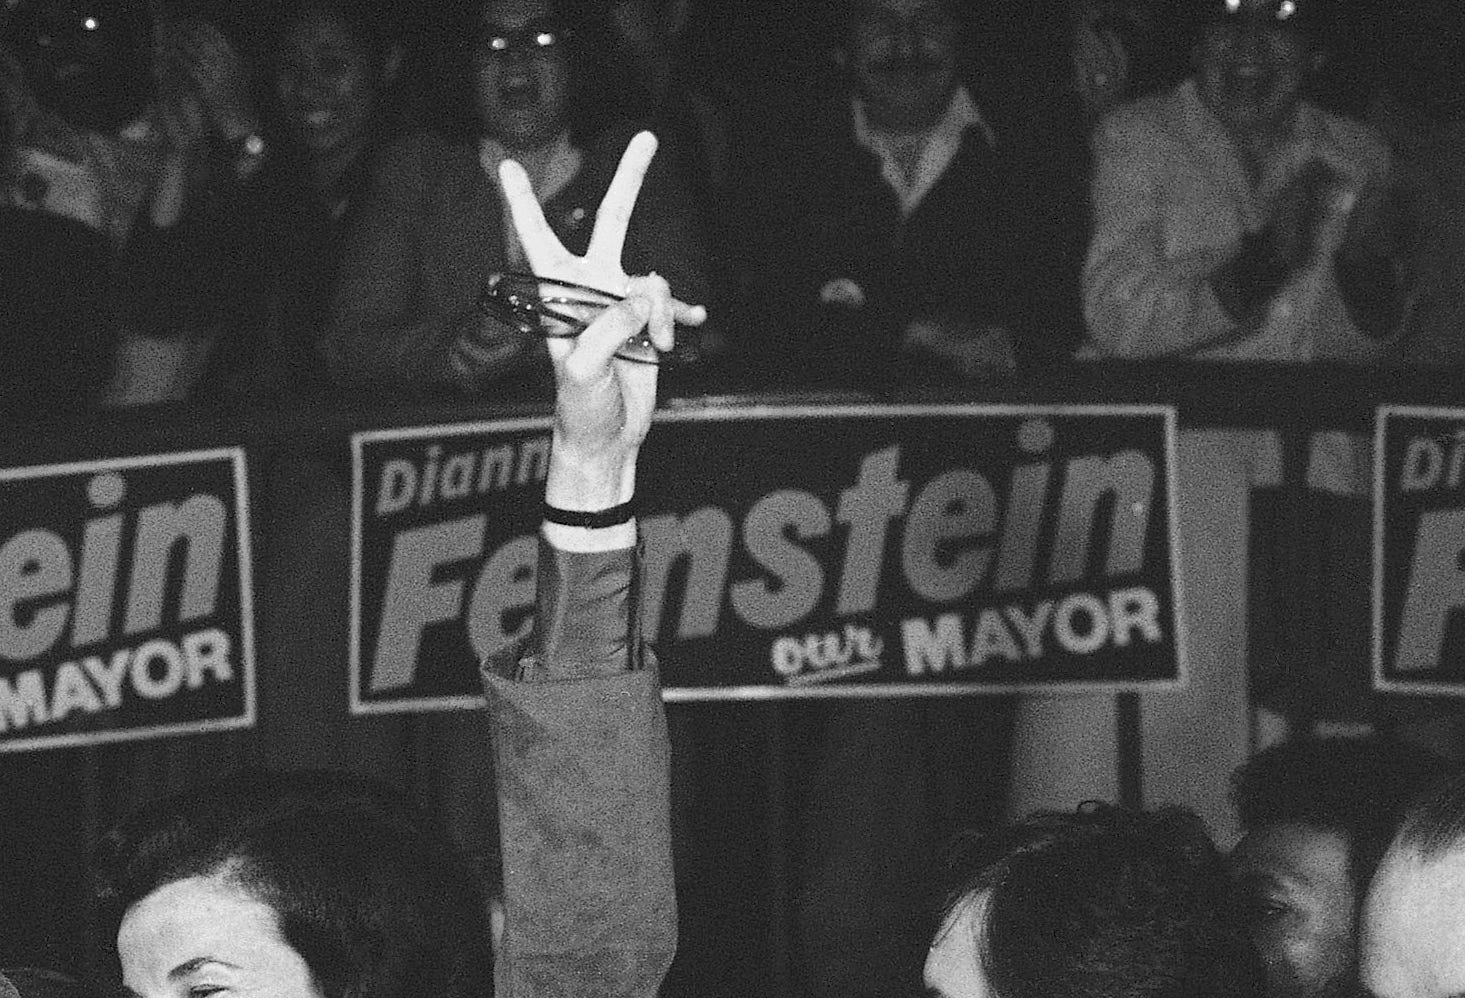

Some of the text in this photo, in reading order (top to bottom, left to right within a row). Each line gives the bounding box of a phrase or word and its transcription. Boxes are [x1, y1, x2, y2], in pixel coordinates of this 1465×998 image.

[376, 439, 549, 514] Diann
[369, 417, 1155, 691] Fenstein
[771, 588, 1161, 680] our MAYOR
